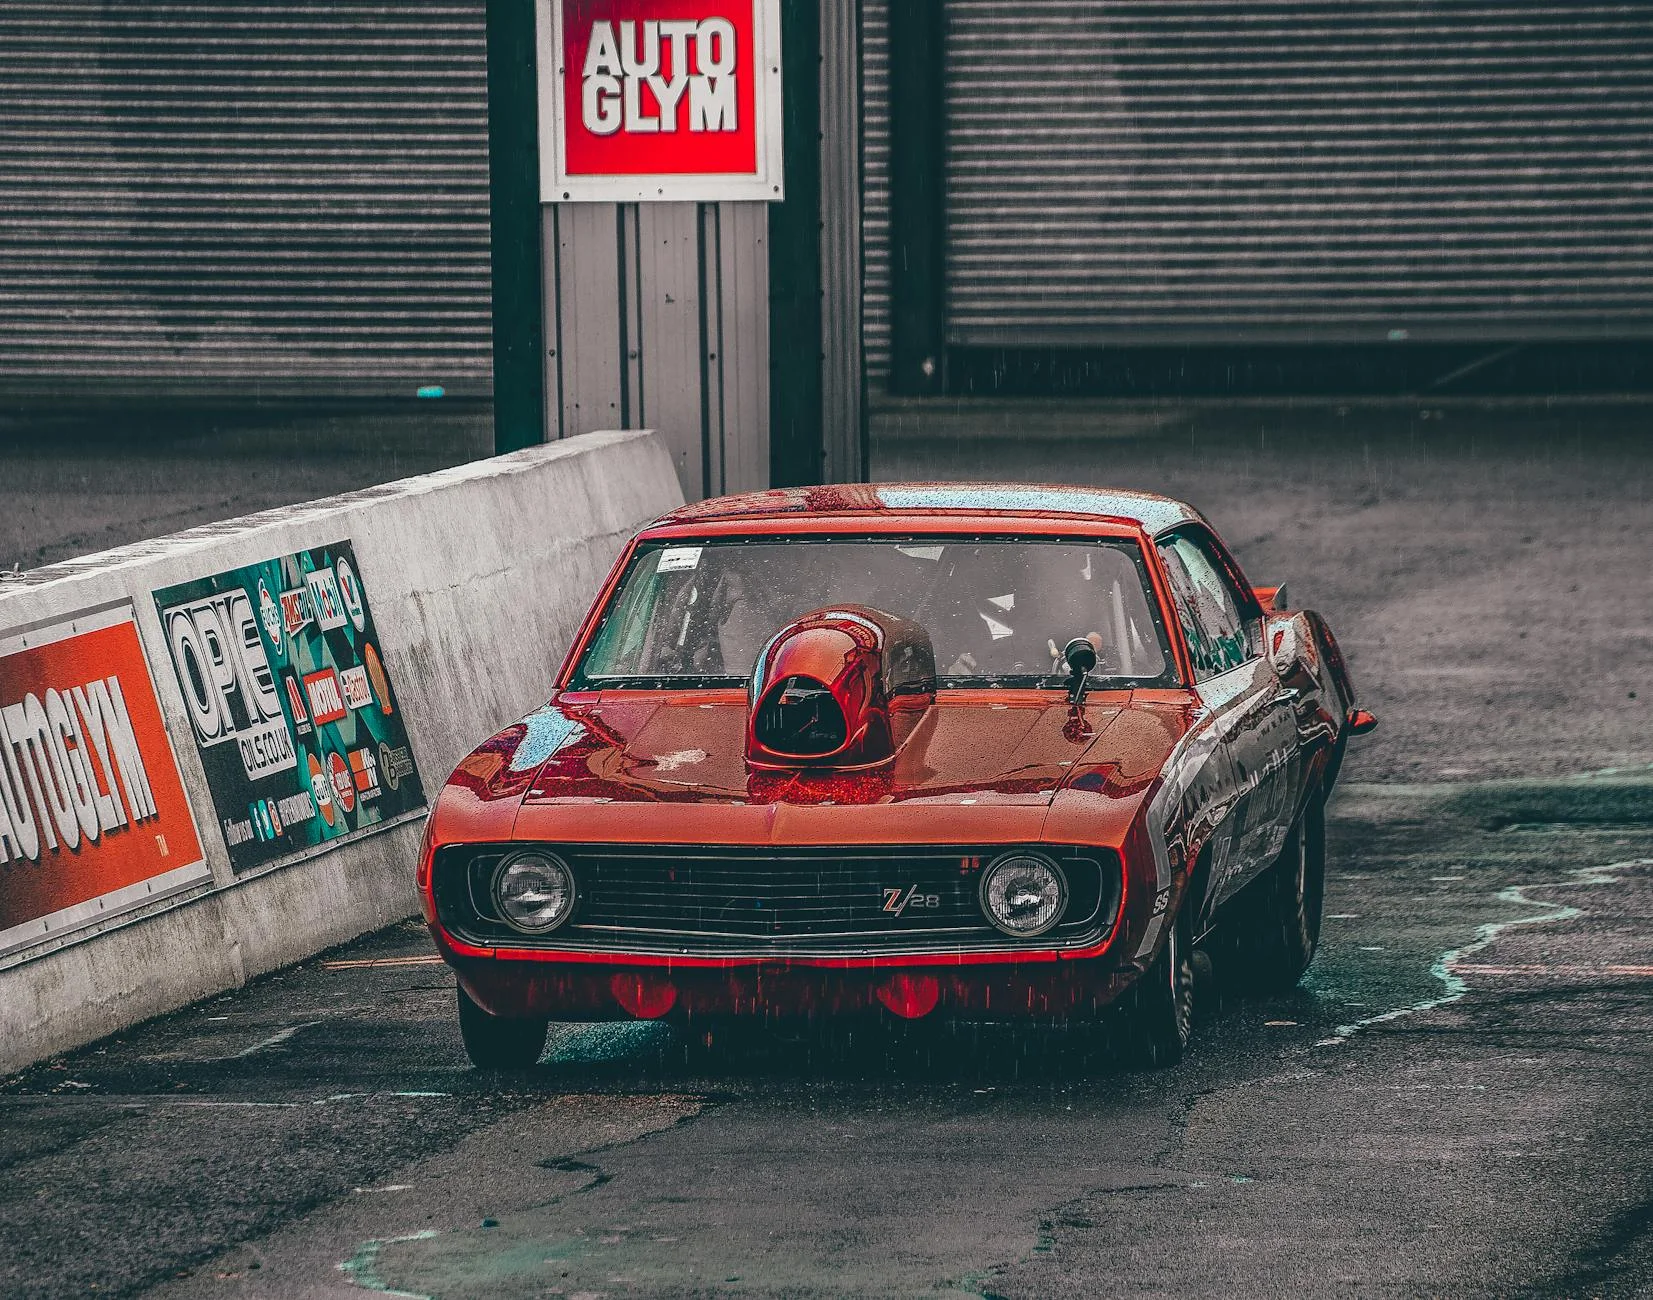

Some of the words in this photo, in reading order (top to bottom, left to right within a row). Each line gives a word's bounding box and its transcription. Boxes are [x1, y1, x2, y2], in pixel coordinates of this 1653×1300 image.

[582, 16, 738, 76] AUTO
[582, 74, 738, 136] GLYM
[310, 577, 343, 621] Mobil
[166, 597, 283, 740] OPIE
[307, 677, 343, 717] MOTUL
[240, 727, 294, 772] OILS.CO.UK
[882, 884, 940, 917] Z/28
[1152, 890, 1170, 914] SS
